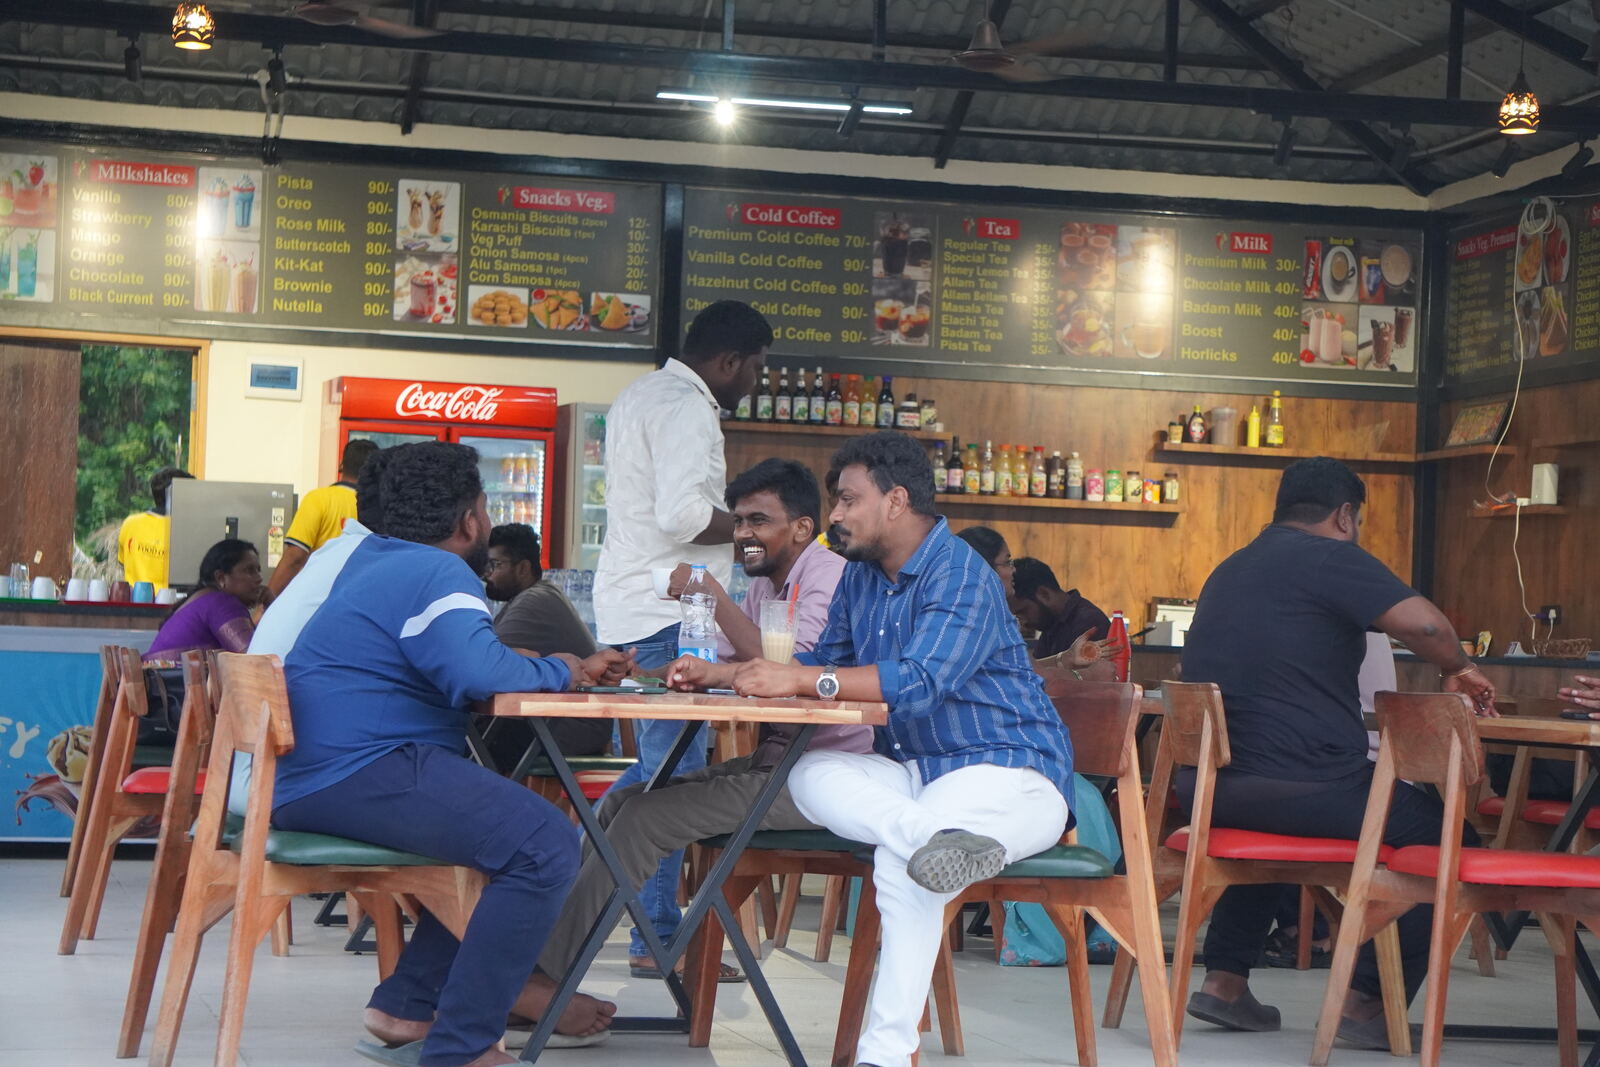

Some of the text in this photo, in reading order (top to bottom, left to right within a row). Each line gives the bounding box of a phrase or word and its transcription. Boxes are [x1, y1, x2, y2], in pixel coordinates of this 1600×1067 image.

[99, 164, 188, 184] Milkshakes
[278, 175, 394, 193] Pista 90/-
[73, 188, 121, 204] Vanilla
[520, 189, 607, 211] Snacks Veg.
[277, 196, 393, 214] Oreo 90/-
[72, 210, 152, 228] Strawberry
[472, 208, 526, 222] Osmania
[530, 212, 578, 225] Biscuits
[746, 208, 835, 225] Cold Coffee
[276, 217, 392, 234] Rose Milk 80/-
[471, 221, 518, 234] Karachi
[522, 224, 570, 237] Biscuits
[985, 222, 1011, 235] Tea
[71, 228, 121, 245] Mango
[471, 233, 493, 247] Veg
[497, 236, 522, 246] Puff
[688, 226, 870, 247] Premium Cold Coffee 70/-
[1234, 236, 1268, 250] Milk
[275, 237, 391, 254] Butterscotch 80/-
[470, 246, 507, 258] Onion
[511, 249, 560, 261] Samosa
[944, 239, 988, 252] Regular
[992, 242, 1011, 251] Tea
[71, 248, 191, 267] Orange 90/-
[688, 250, 869, 271] Vanilla Cold Coffee 90/-
[944, 252, 985, 264] Special
[989, 254, 1008, 264] Tea
[1184, 254, 1300, 272] Premium Milk 30/-
[274, 258, 391, 275] Kit-Kat 90/-
[470, 259, 491, 270] Alu
[495, 261, 543, 273] Samosa
[626, 268, 648, 278] 20/-
[943, 265, 973, 277] Honey
[977, 267, 1009, 277] Lemon
[1012, 268, 1029, 278] Tea
[70, 269, 190, 286] Chocolate 90/-
[469, 271, 499, 283] Corn
[503, 273, 551, 286] Samosa
[625, 281, 647, 291] 40/-
[687, 275, 869, 295] Hazelnut Cold Coffee 90/-
[943, 277, 975, 287] Allam
[978, 279, 998, 289] Tea
[1184, 277, 1299, 294] Chocolate Milk 40/-
[273, 278, 390, 295] Brownie 90/-
[69, 288, 189, 307] Black Current 90/-
[1011, 293, 1028, 304] Tea
[273, 299, 389, 316] Nutella 90/-
[782, 304, 821, 317] Coffee
[842, 307, 868, 319] 90/-
[942, 303, 982, 313] Masala
[986, 305, 1004, 315] Tea
[1183, 301, 1298, 318] Badam Milk 40/-
[941, 315, 976, 325] Elachi
[980, 317, 999, 327] Tea
[786, 328, 831, 342] Coffee
[841, 331, 866, 343] 90/-
[941, 328, 980, 338] Badam
[984, 330, 1003, 340] Tea
[1182, 324, 1298, 340] Boost 40/-
[940, 340, 968, 350] Pista
[972, 342, 992, 352] Tea
[1181, 348, 1297, 364] Horlicks 40/-
[395, 383, 504, 421] Coca-Cola
